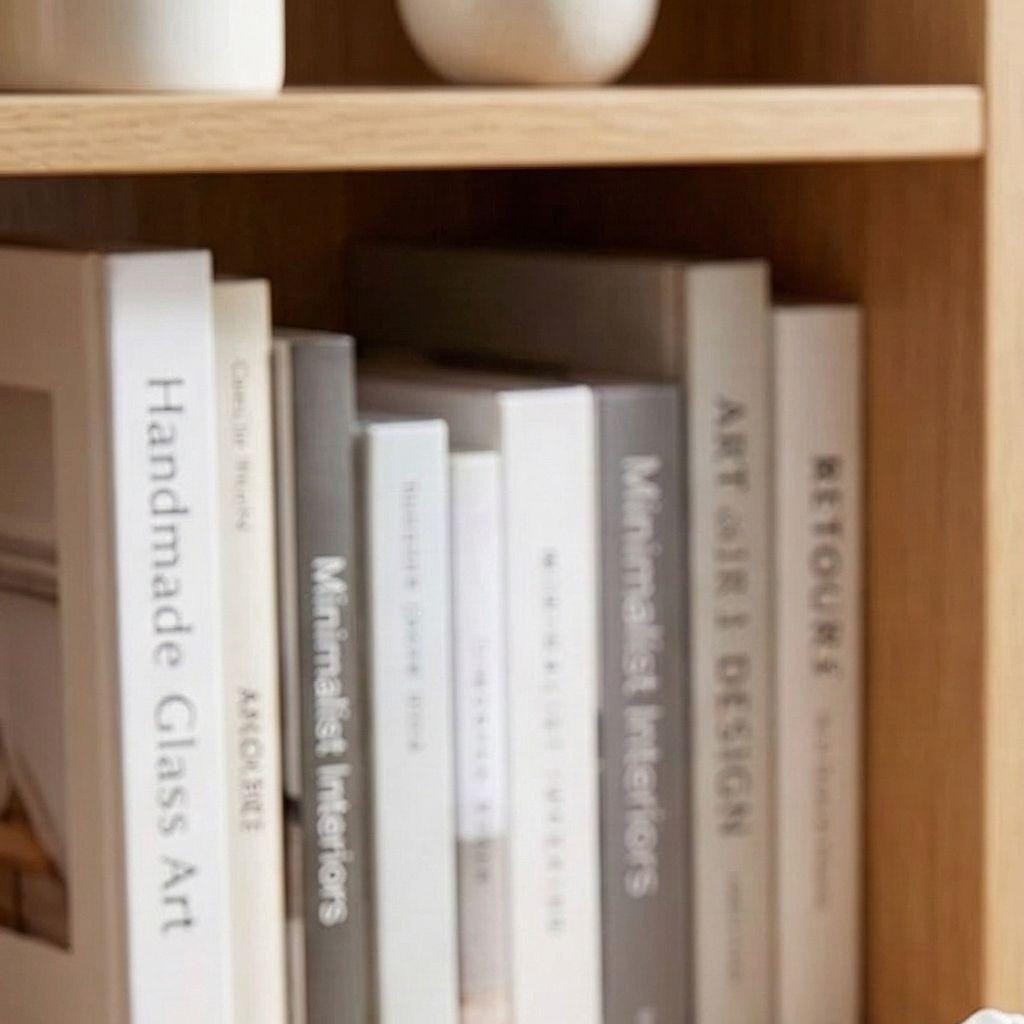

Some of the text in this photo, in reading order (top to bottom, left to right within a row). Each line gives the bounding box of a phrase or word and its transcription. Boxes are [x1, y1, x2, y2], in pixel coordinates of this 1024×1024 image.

[145, 376, 197, 934] Handmade Glass Art
[311, 556, 352, 926] Minimalist Interiors
